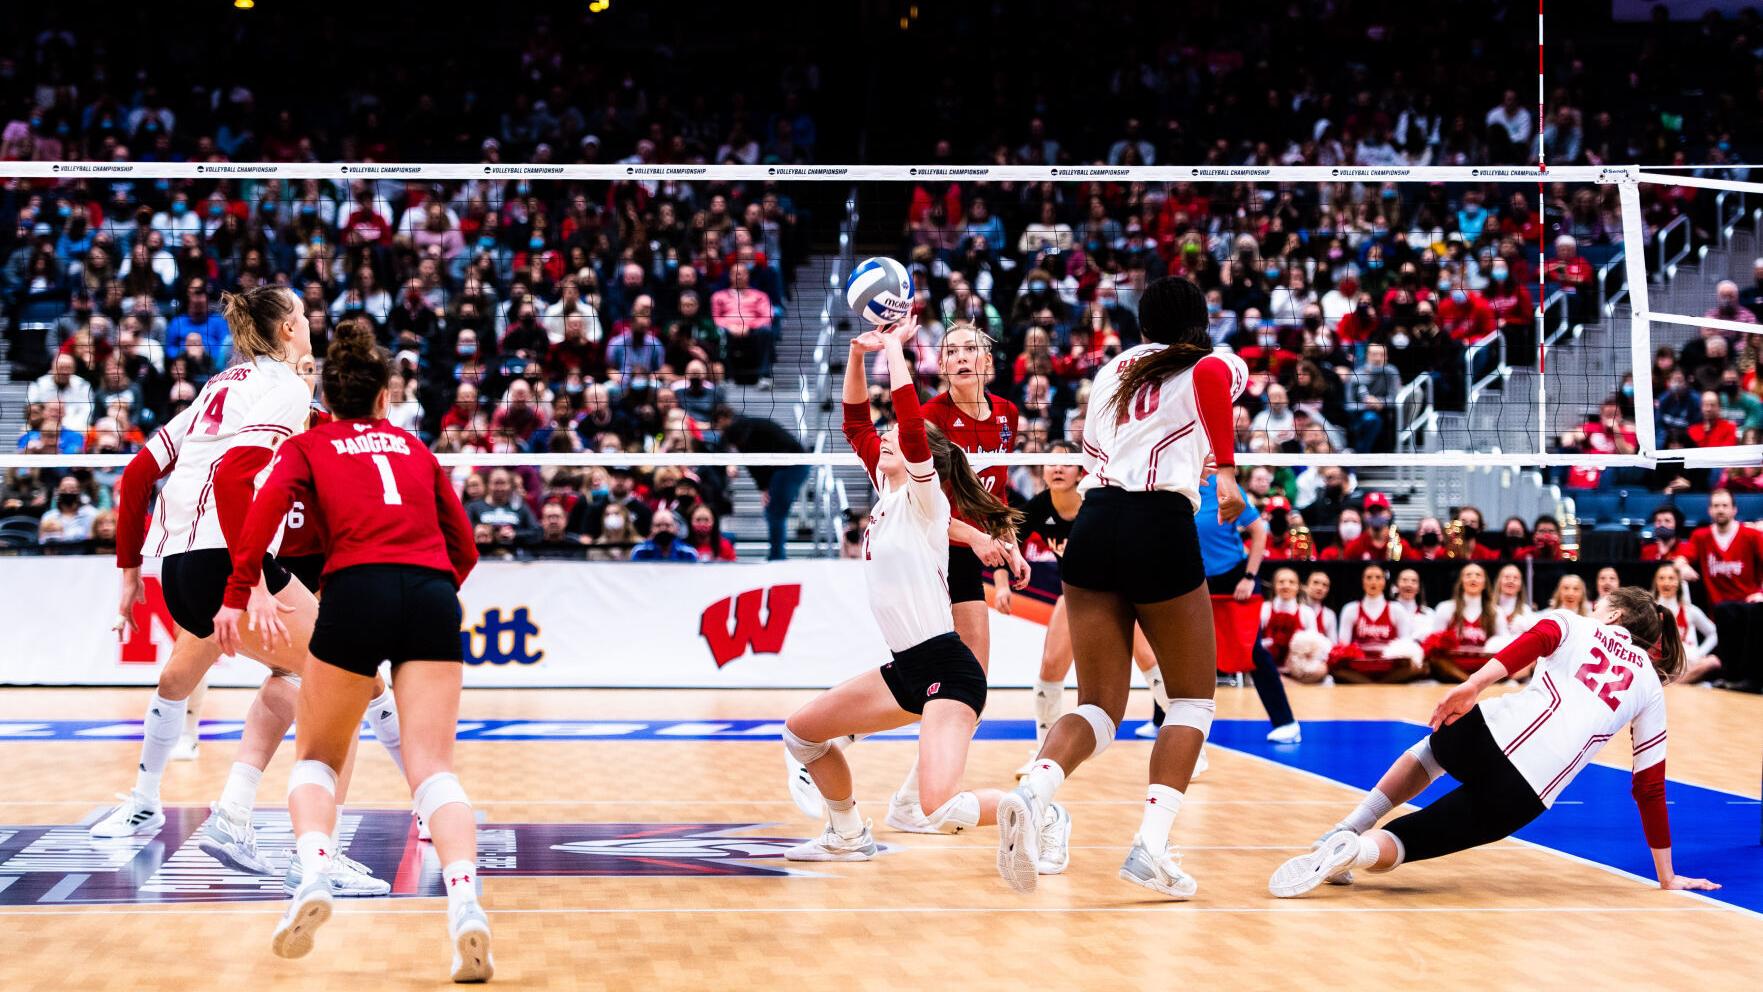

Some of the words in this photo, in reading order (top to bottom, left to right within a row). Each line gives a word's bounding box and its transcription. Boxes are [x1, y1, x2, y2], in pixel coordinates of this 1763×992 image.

[330, 432, 411, 456] BADGERS
[371, 453, 403, 506] 1
[698, 583, 802, 669] W
[1593, 626, 1644, 669] BADGERS
[1574, 646, 1634, 713] 22
